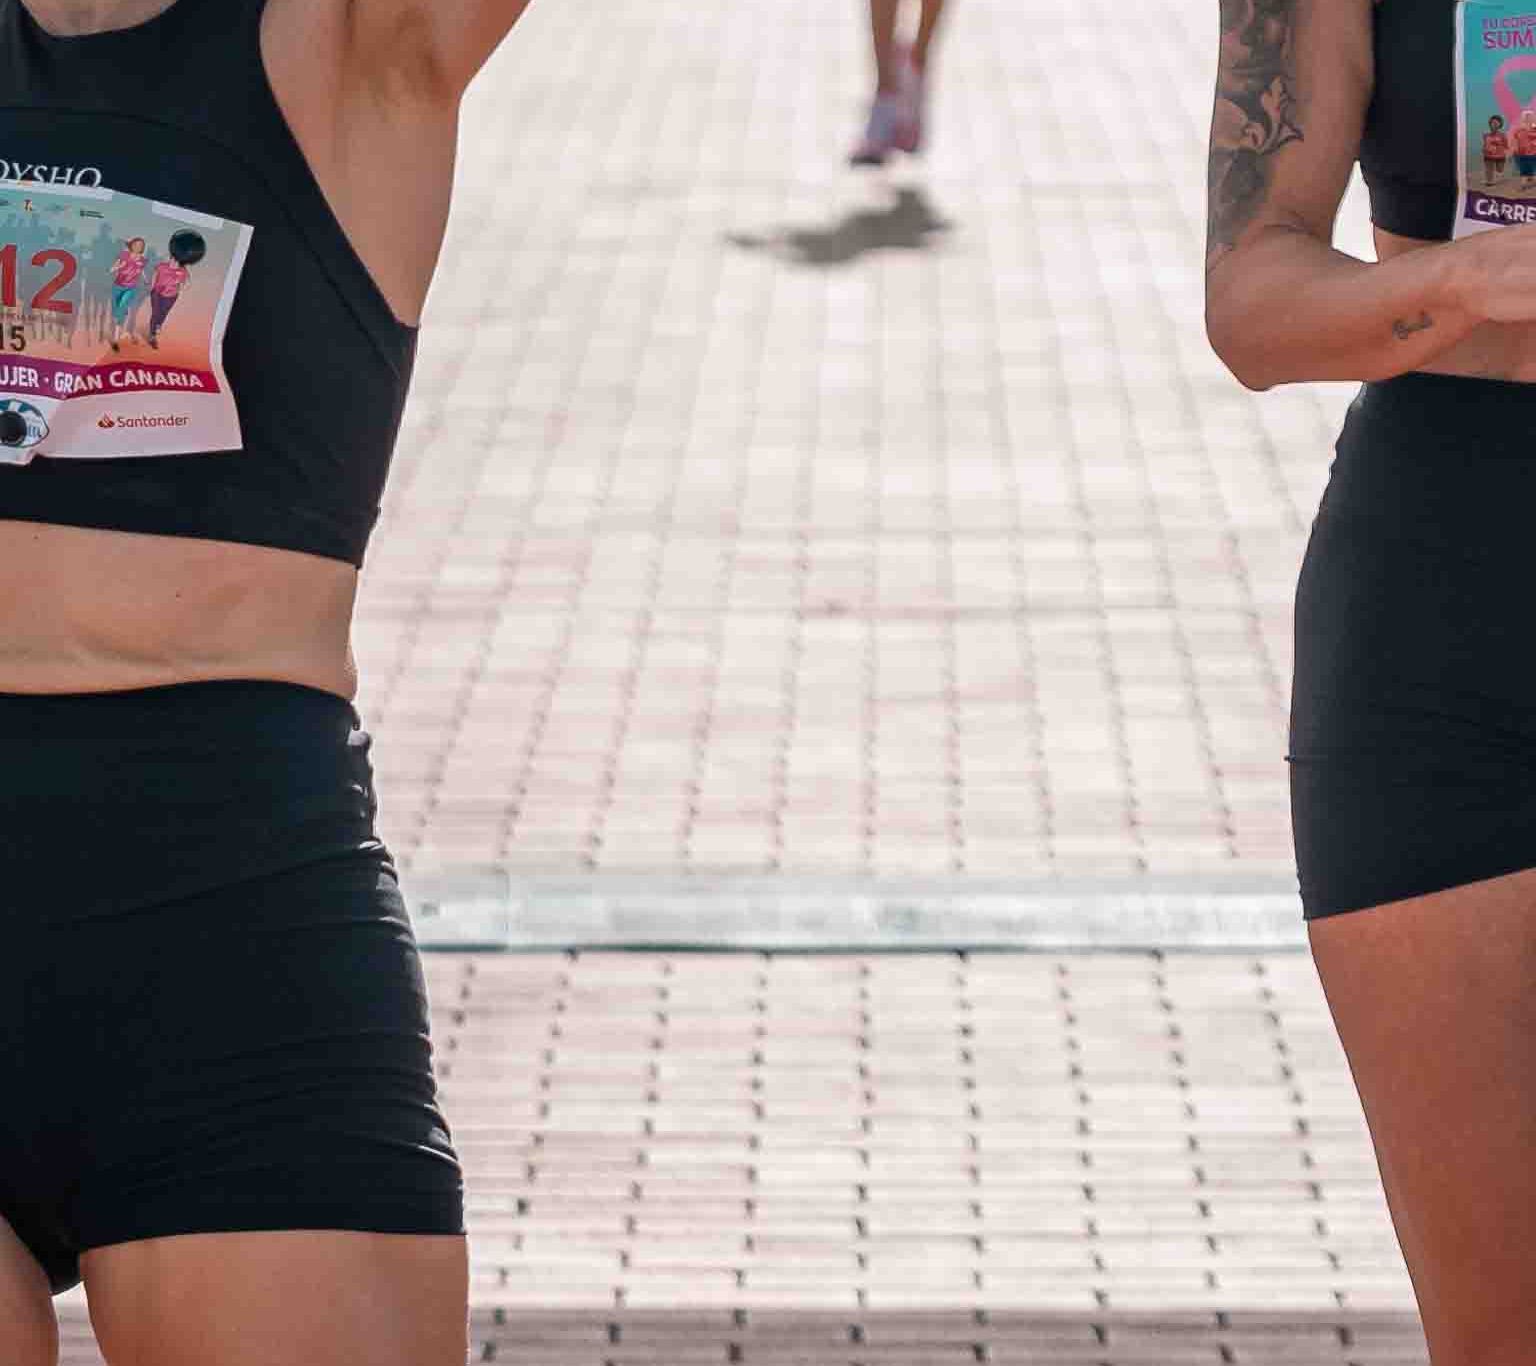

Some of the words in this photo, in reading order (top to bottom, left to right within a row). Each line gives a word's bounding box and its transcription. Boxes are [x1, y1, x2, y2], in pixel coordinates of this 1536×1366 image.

[54, 370, 104, 393] GRAN
[108, 368, 205, 389] CANARIA
[116, 413, 190, 429] Santander
